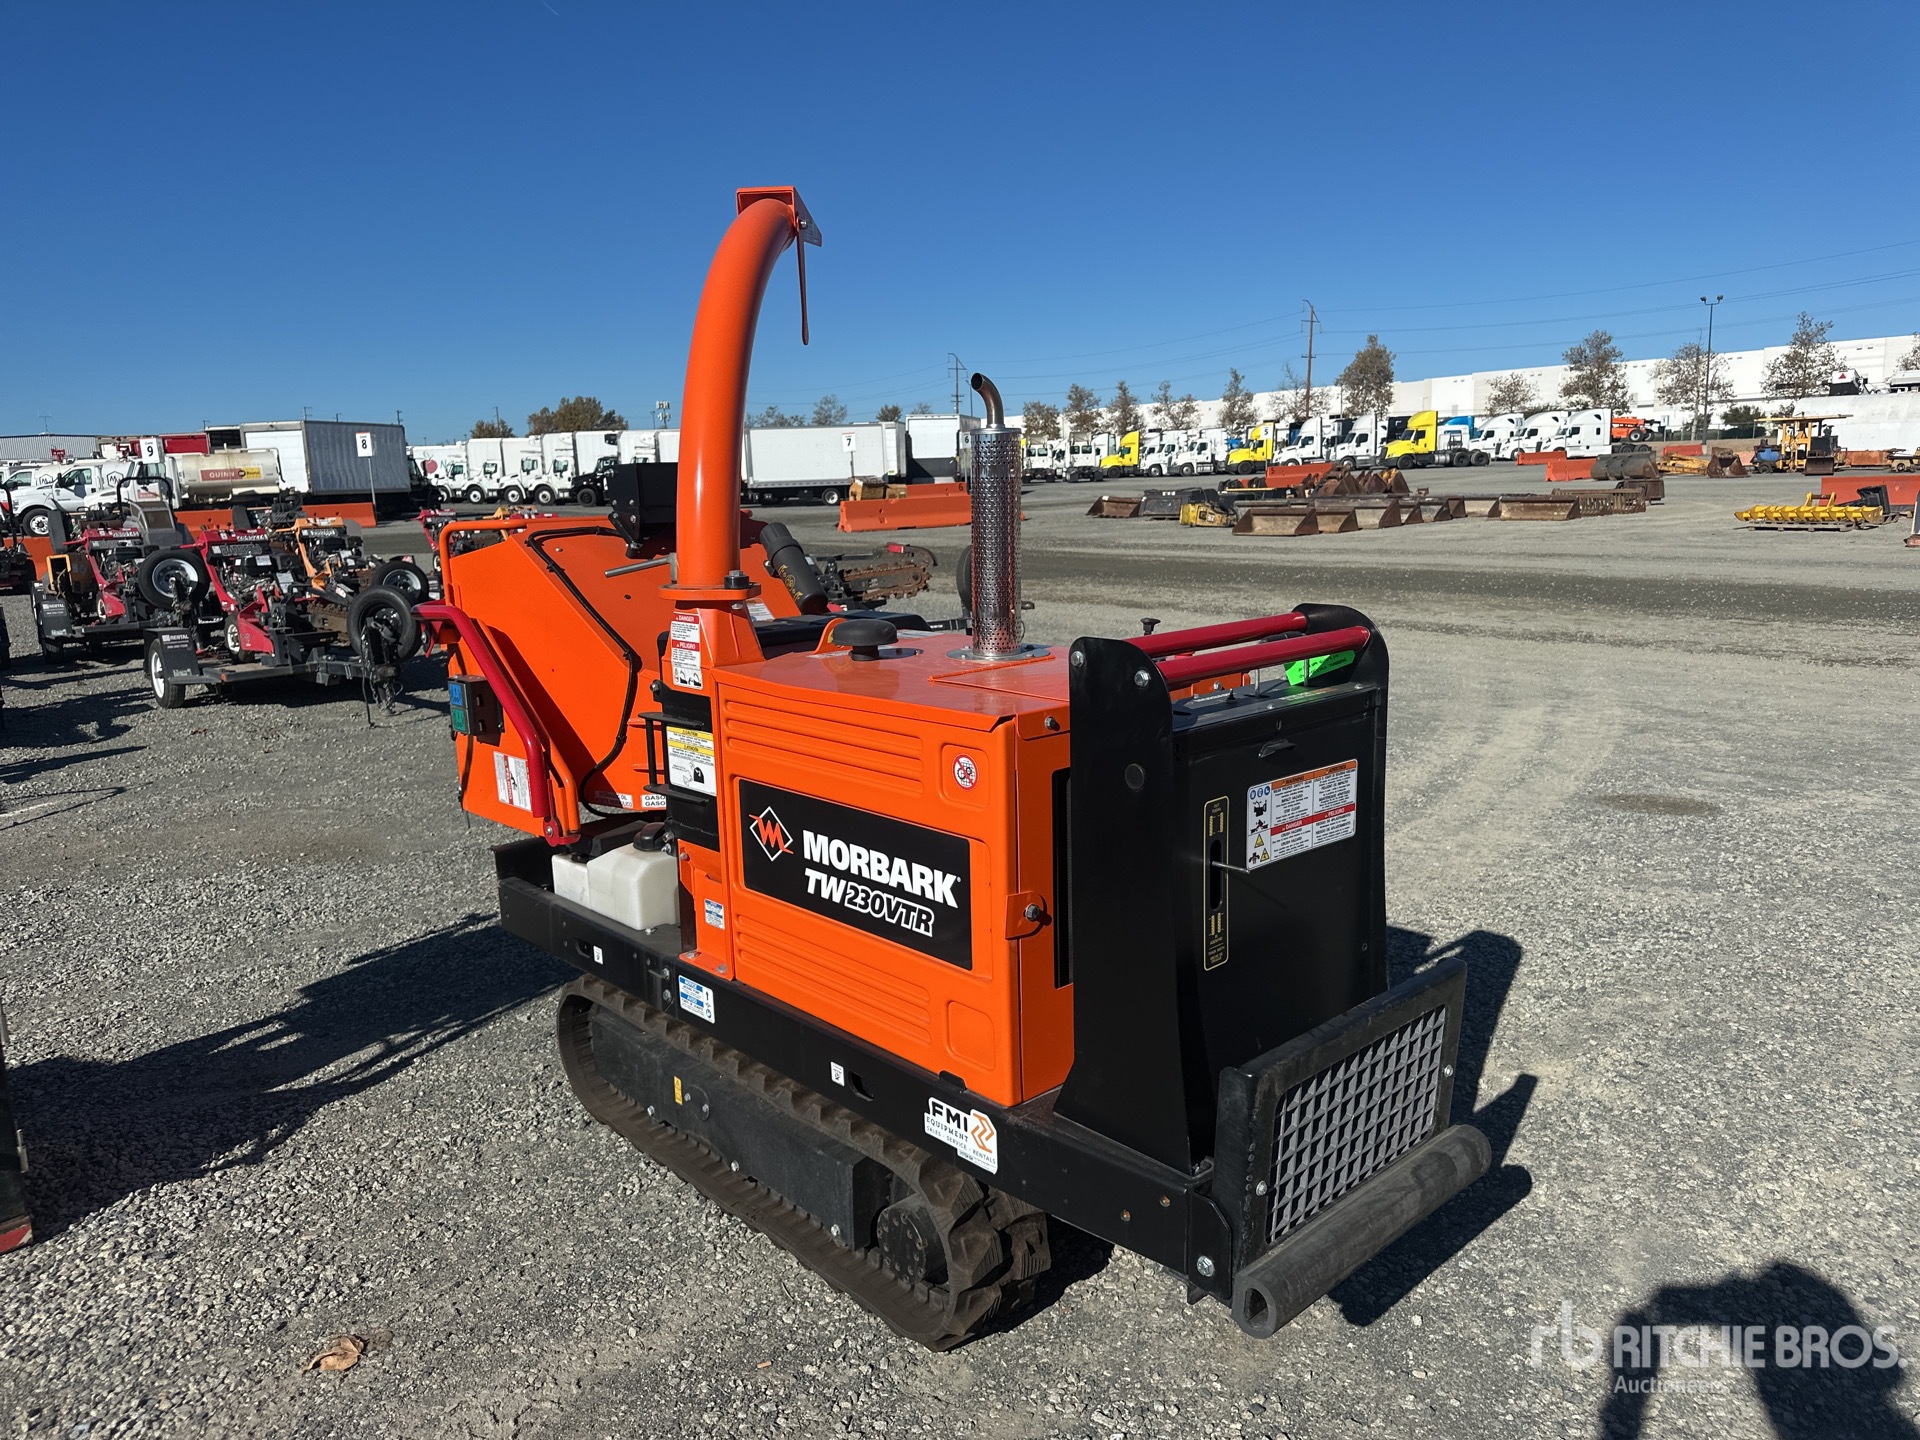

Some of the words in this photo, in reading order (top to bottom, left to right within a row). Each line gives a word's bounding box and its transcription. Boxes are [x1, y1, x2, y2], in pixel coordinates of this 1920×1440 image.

[362, 439, 367, 449] 8
[846, 438, 851, 446] 7
[964, 436, 970, 444] 6
[147, 446, 154, 456] 9
[958, 483, 964, 491] 6
[1328, 808, 1345, 817] PELIGRO
[1286, 820, 1302, 829] DANGER
[803, 830, 958, 908] MORBARK
[804, 868, 935, 938] TW230VTR
[932, 1100, 968, 1132] FMI
[926, 1116, 968, 1142] EQUIPMENT
[926, 1125, 941, 1137] SALES
[947, 1135, 967, 1150] SERVICE
[972, 1150, 996, 1164] RENTALS
